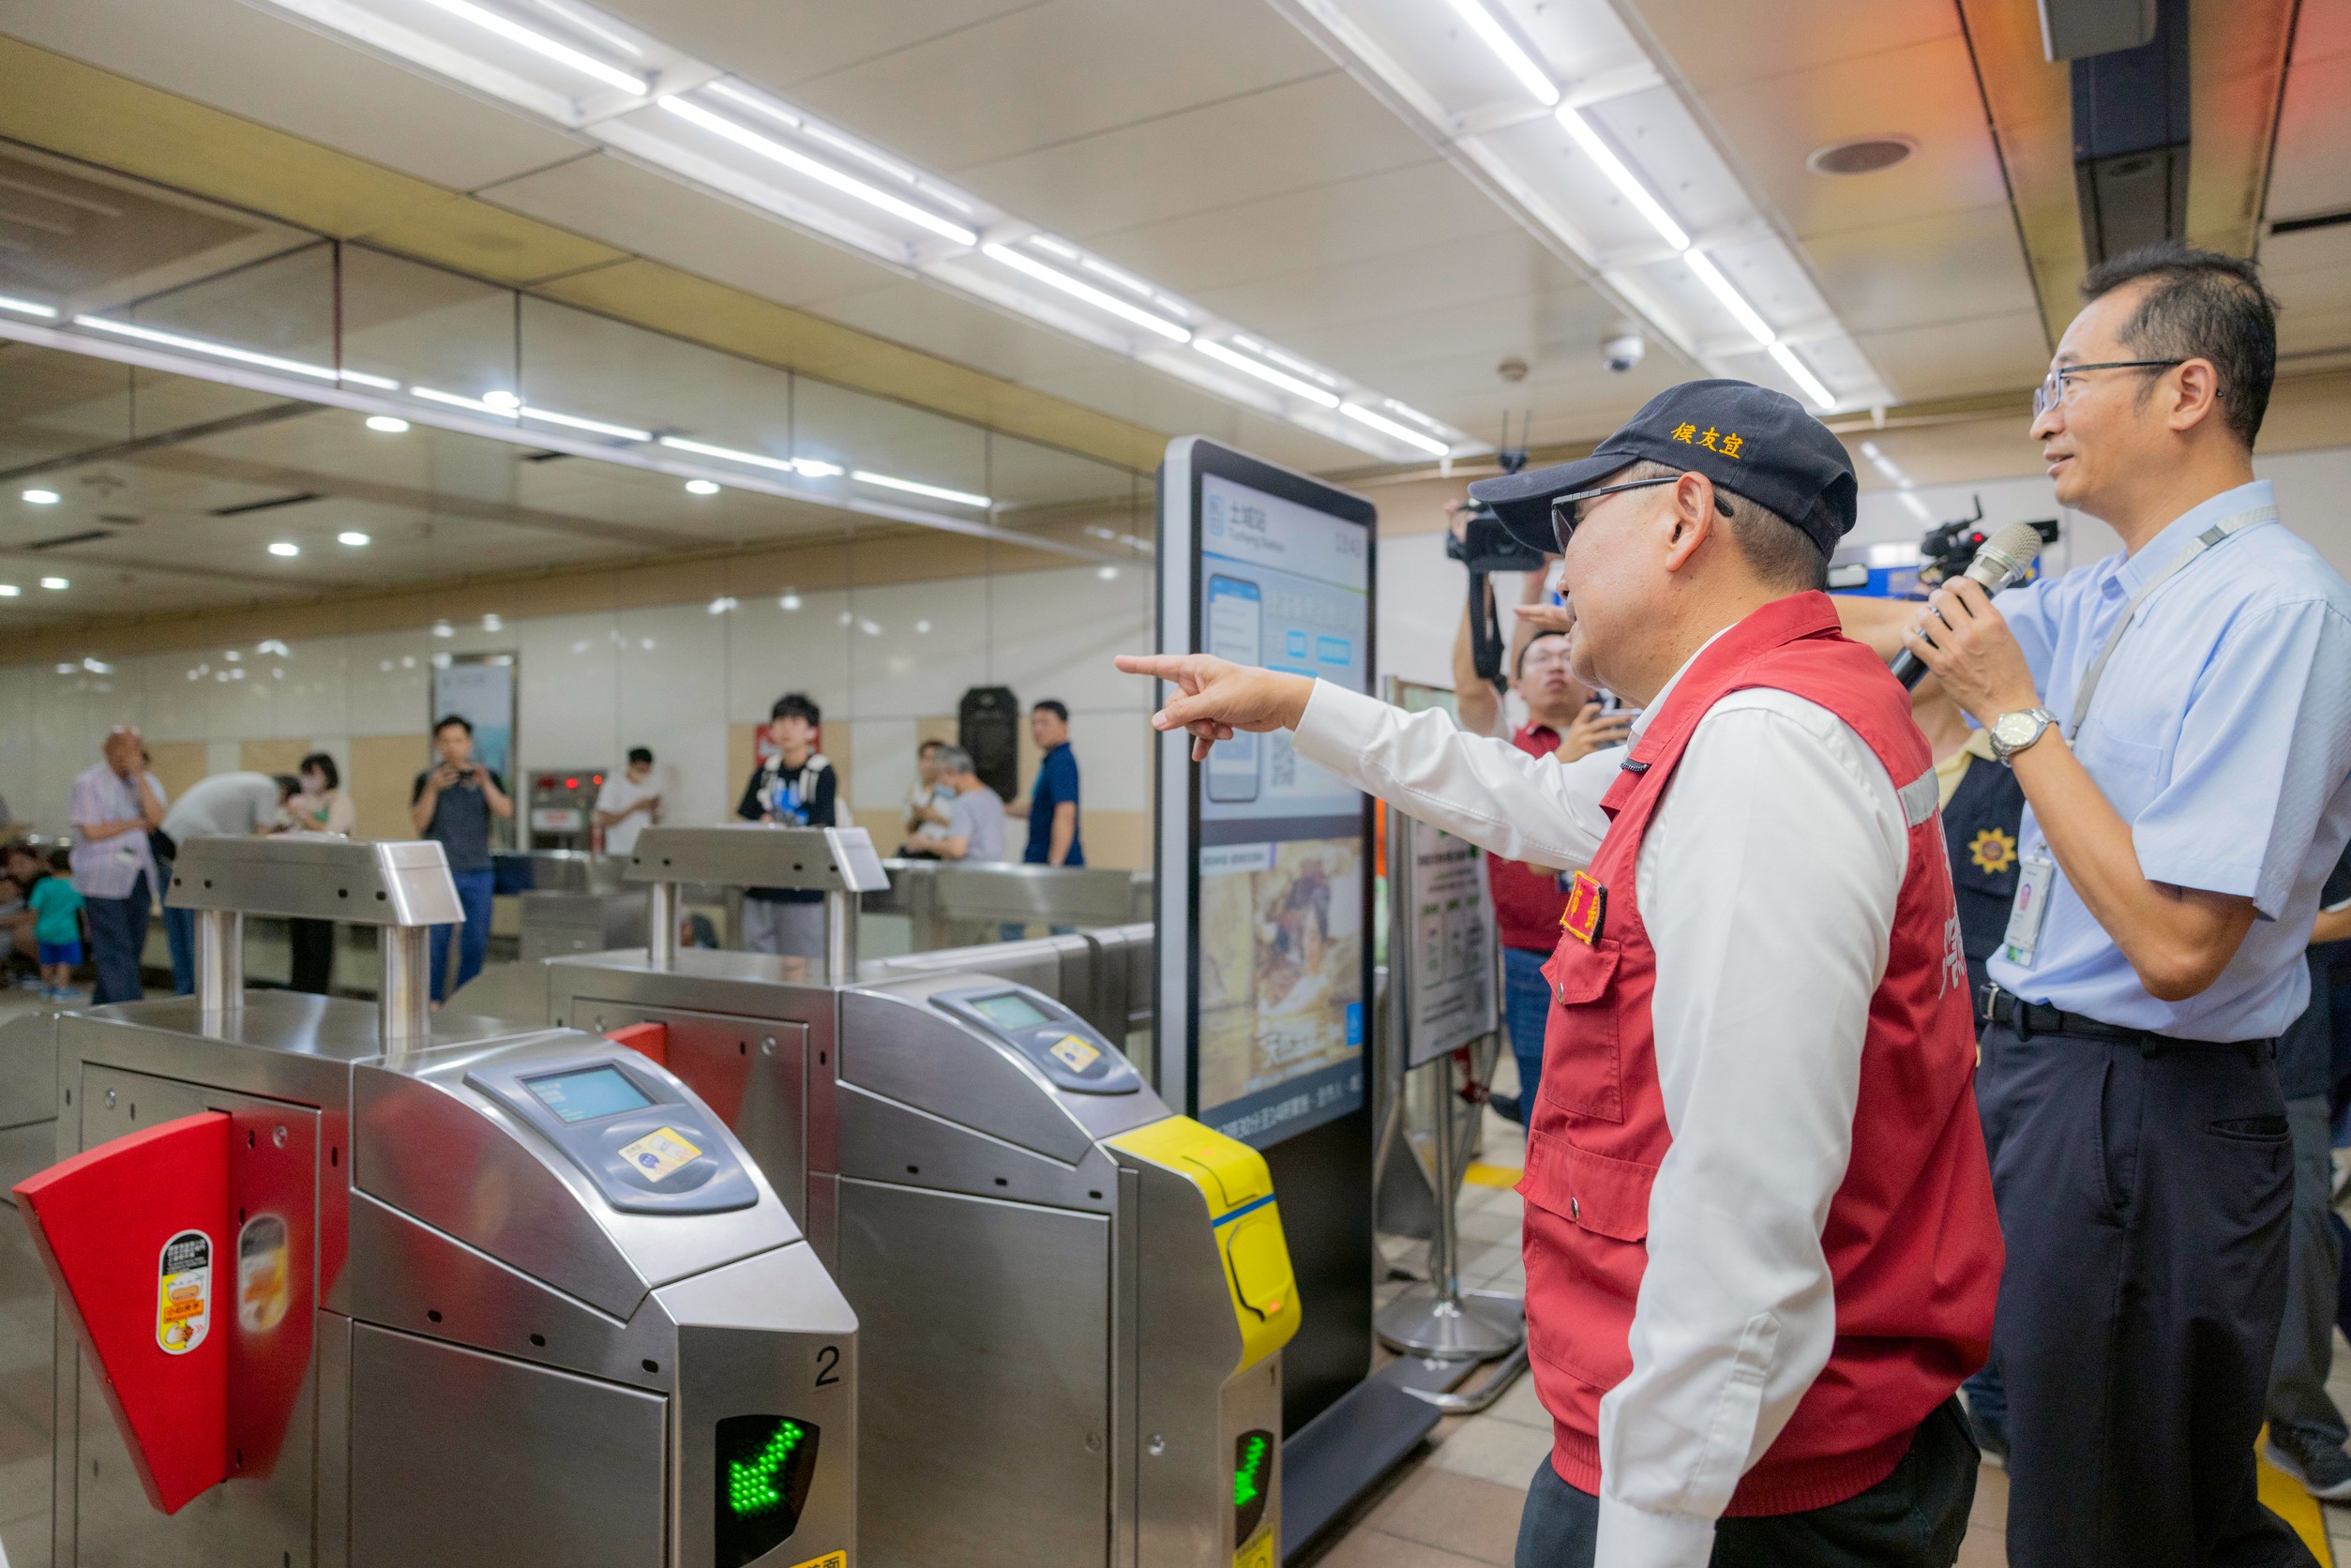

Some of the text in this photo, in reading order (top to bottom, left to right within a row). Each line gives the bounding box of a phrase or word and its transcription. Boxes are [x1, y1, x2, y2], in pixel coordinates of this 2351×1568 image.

[1670, 421, 1743, 460] 侯友宜
[814, 1345, 840, 1388] 2
